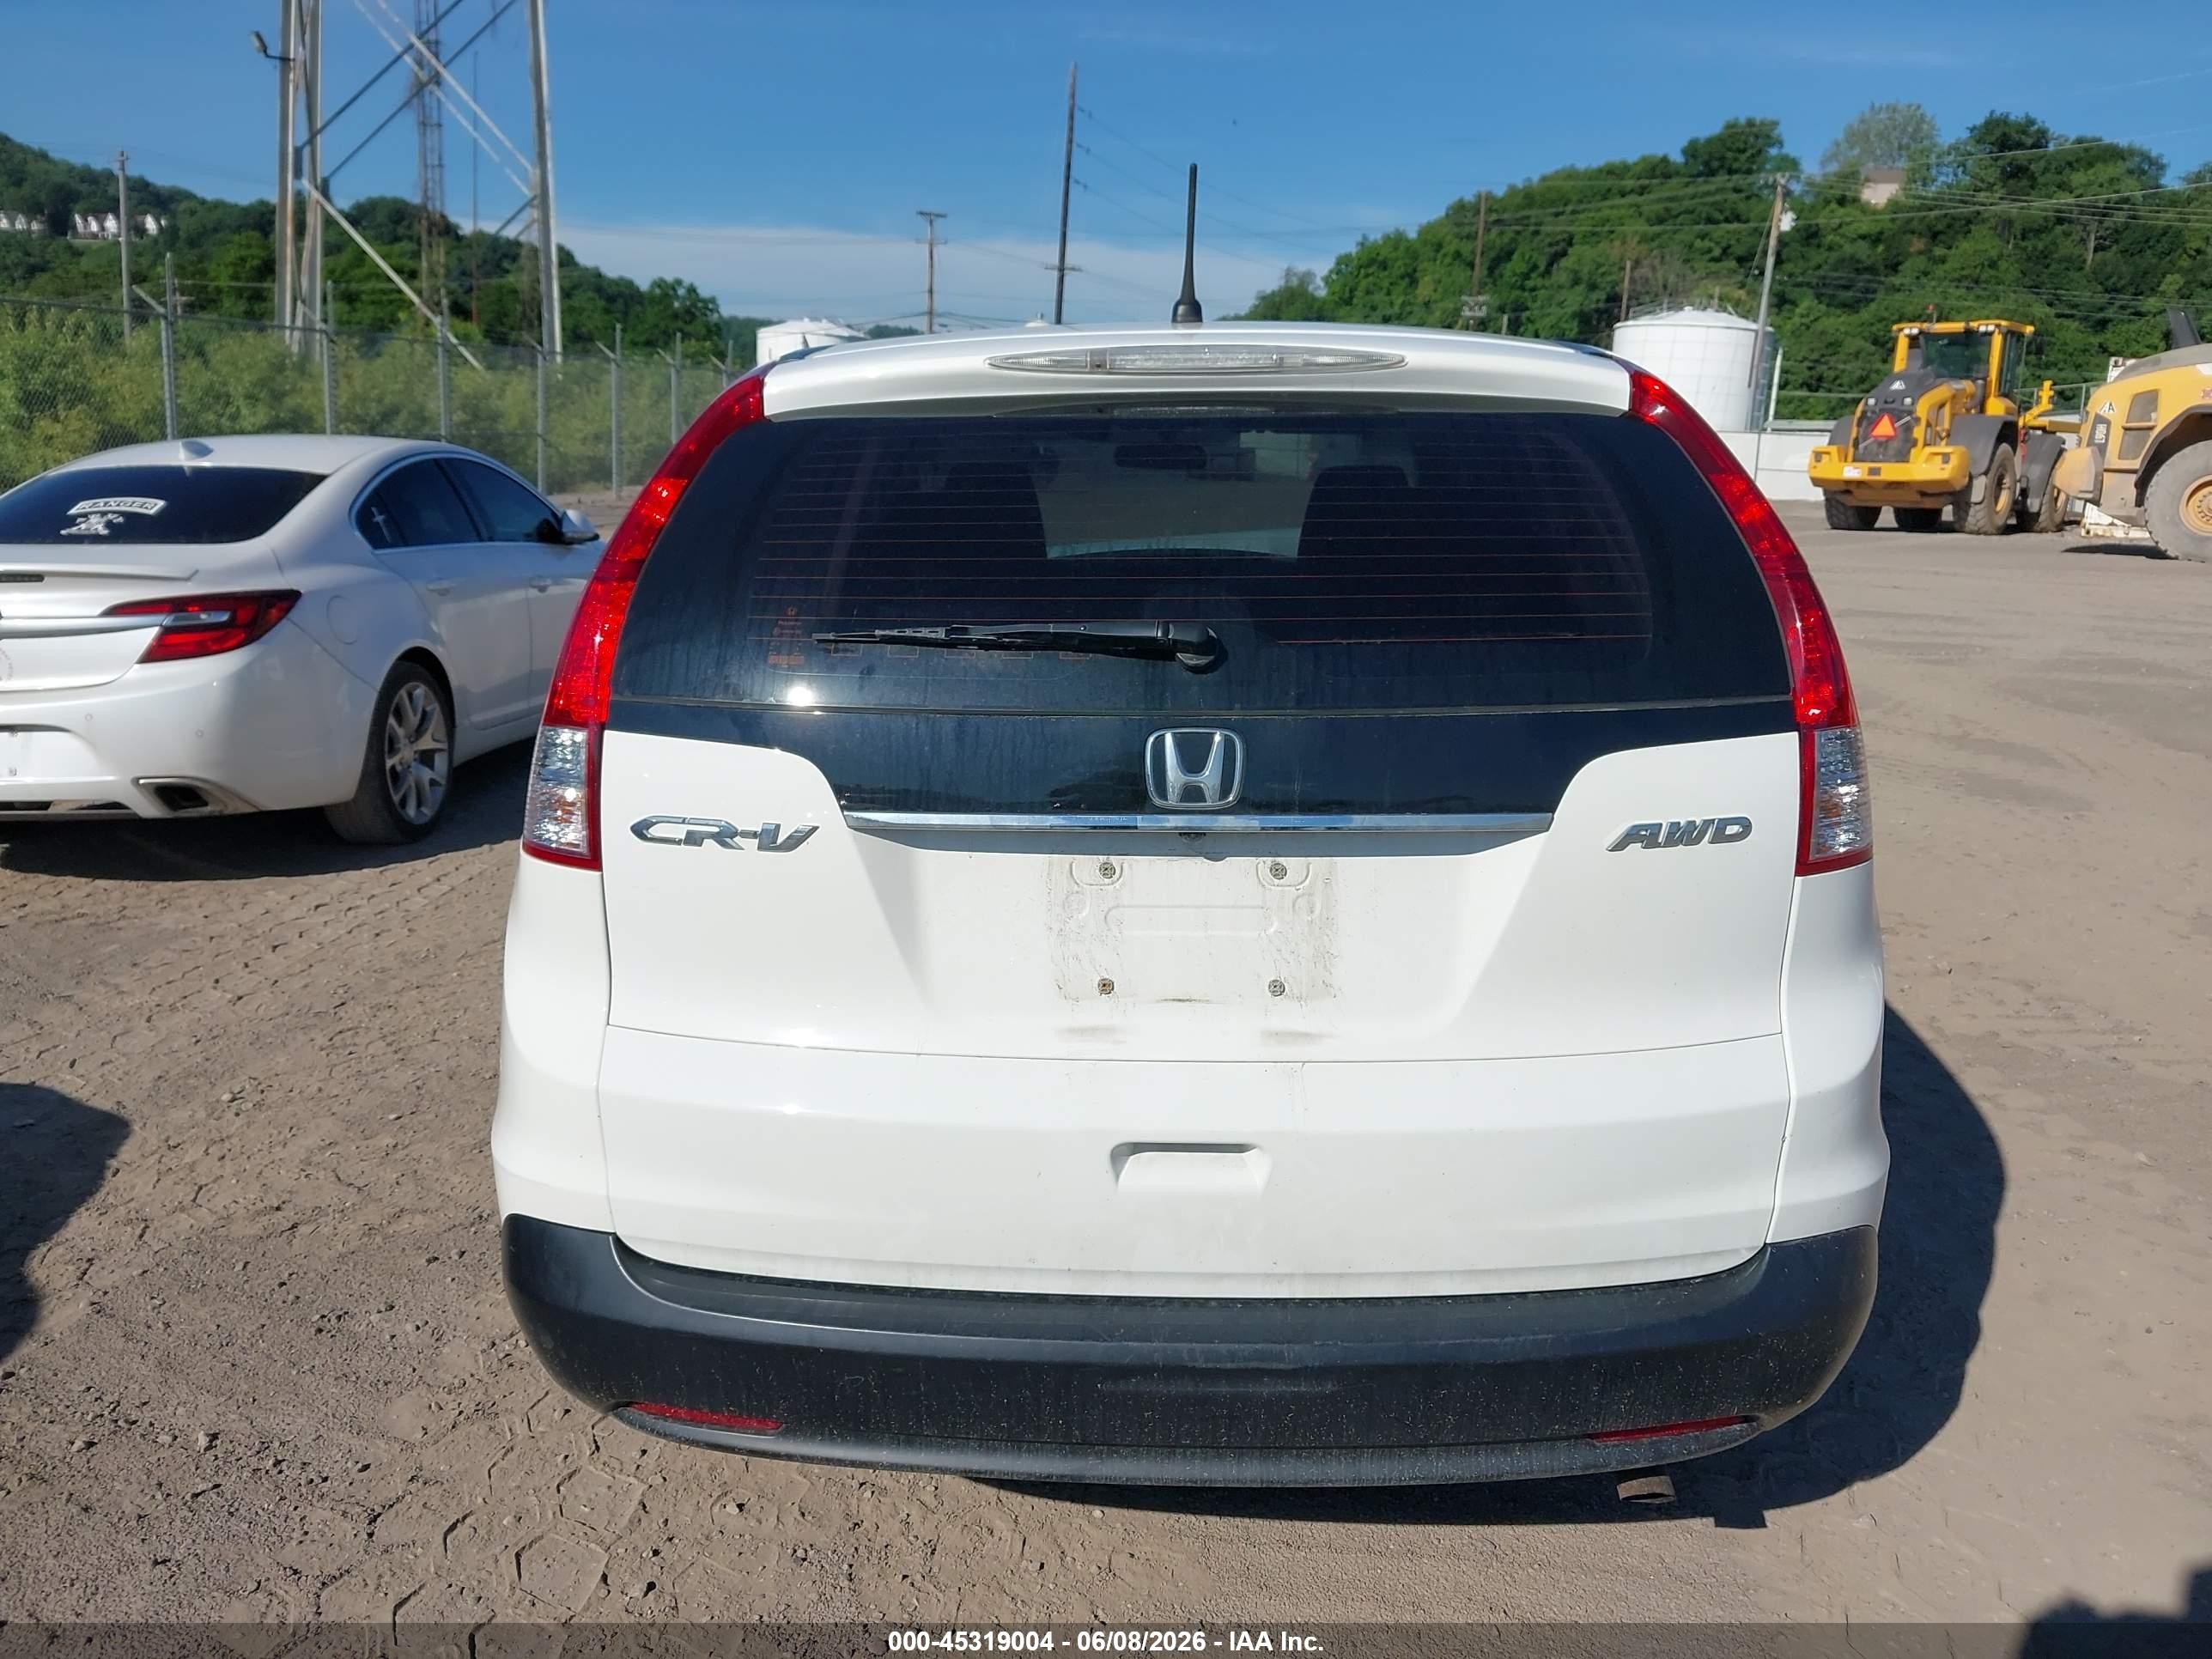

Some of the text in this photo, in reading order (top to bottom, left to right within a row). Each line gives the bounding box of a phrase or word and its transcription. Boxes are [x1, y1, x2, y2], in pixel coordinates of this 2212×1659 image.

[78, 501, 157, 510] RANGER
[630, 816, 819, 853] CR-V
[1606, 817, 1753, 851] AWD
